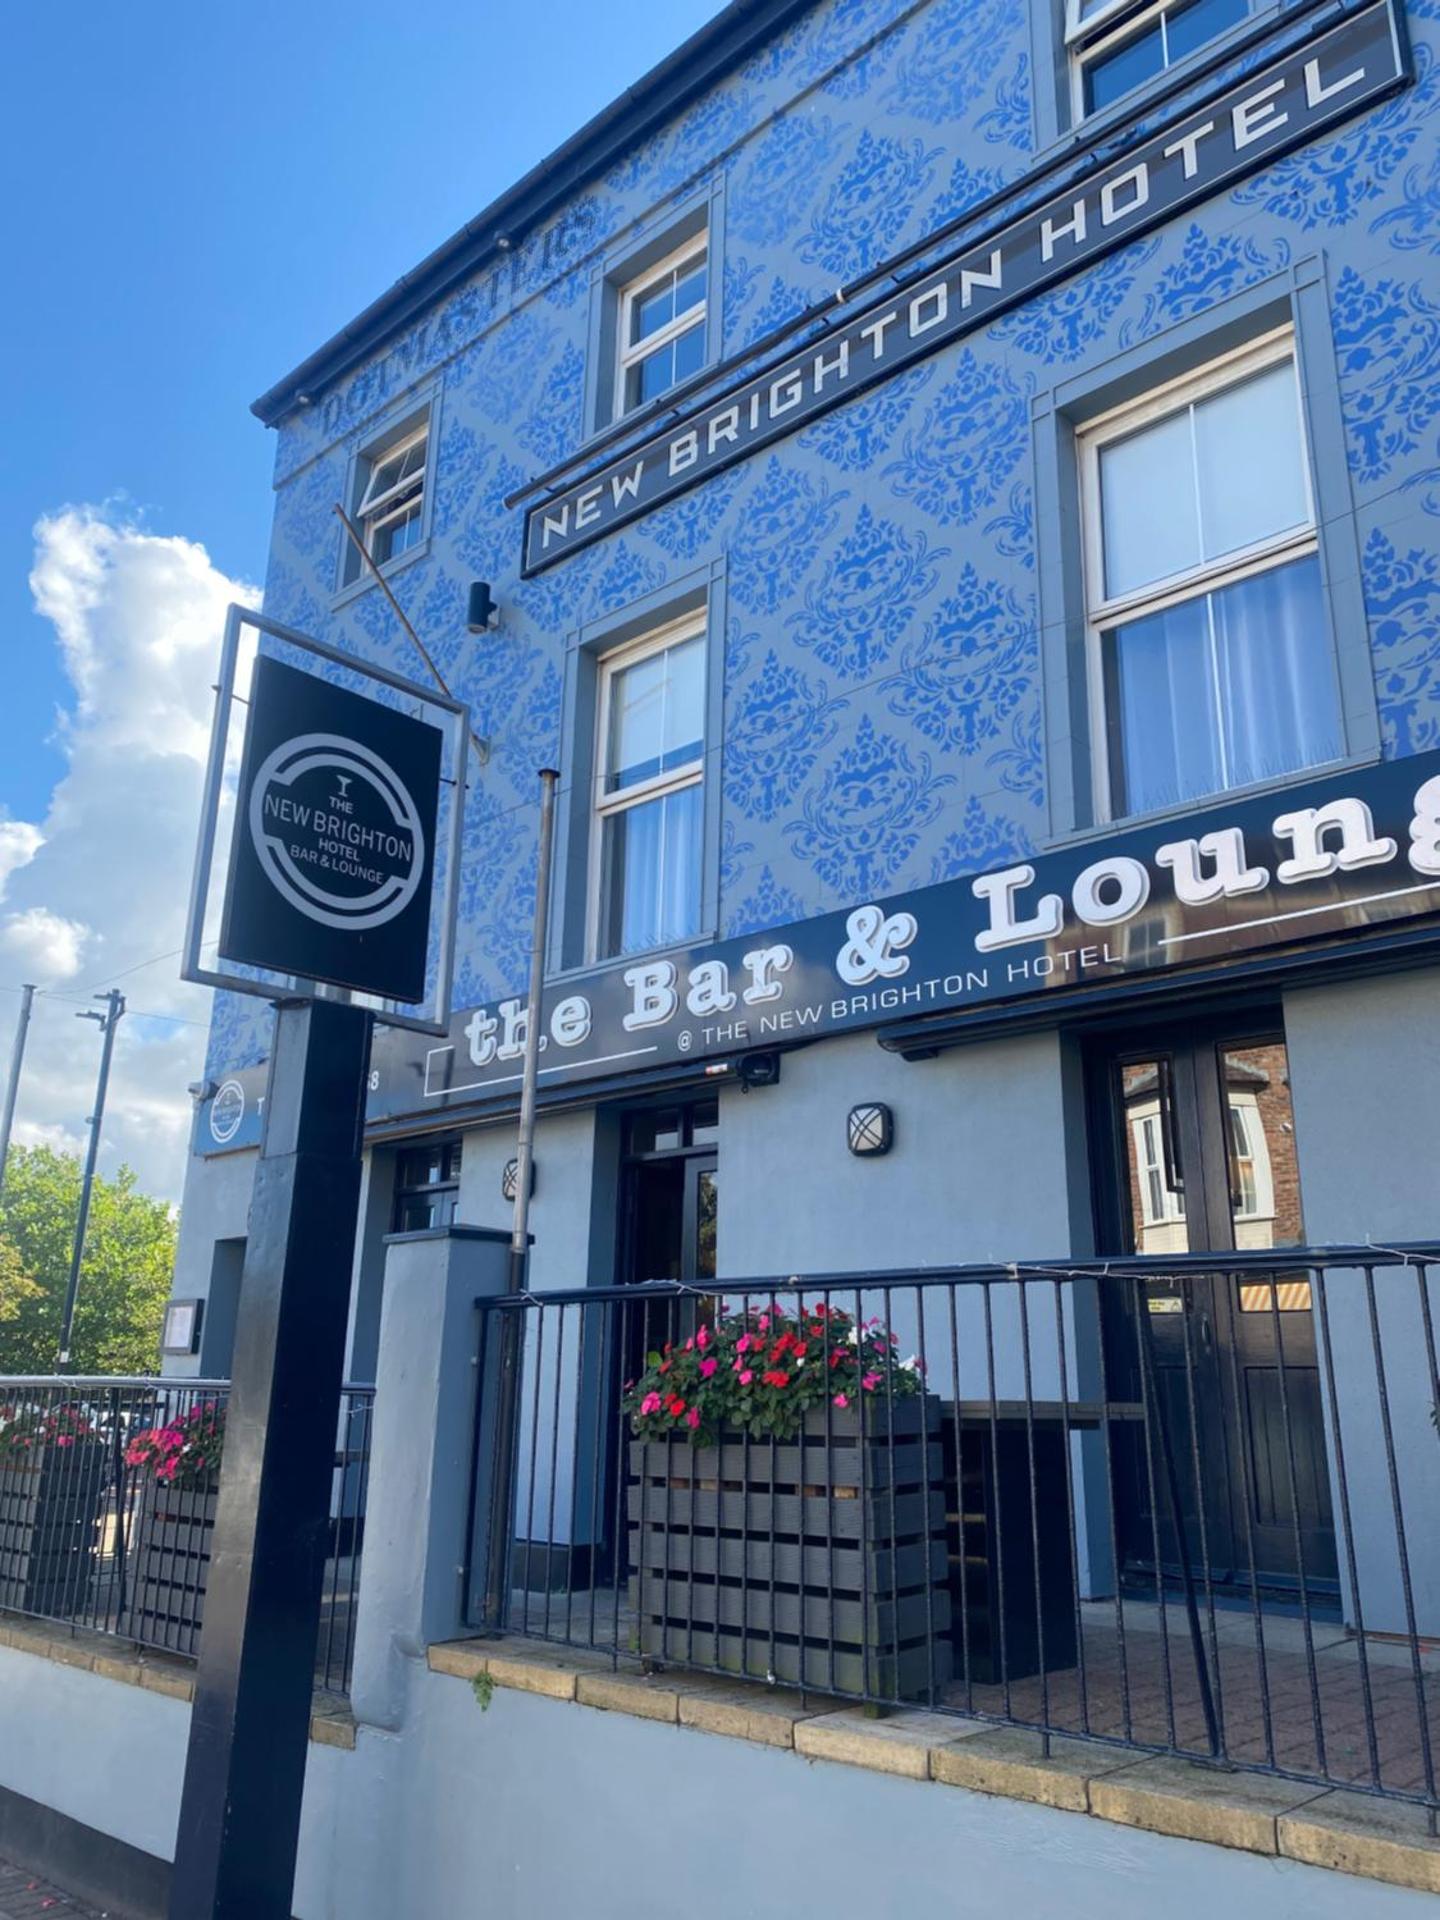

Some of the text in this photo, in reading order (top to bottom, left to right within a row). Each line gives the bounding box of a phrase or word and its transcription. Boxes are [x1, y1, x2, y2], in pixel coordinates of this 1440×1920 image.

[541, 58, 1366, 549] NEW BRIGHTON HOTEL
[264, 794, 412, 863] NEW BRIGHTON
[329, 796, 353, 815] THE
[290, 844, 318, 864] BAR
[331, 858, 384, 885] LOUNGE
[319, 837, 361, 862] HOTEL
[464, 995, 592, 1066] the
[622, 943, 795, 1032] Bar
[836, 905, 918, 986] &
[678, 943, 1121, 1051] @ THE NEW BRIGHTON HOTEL
